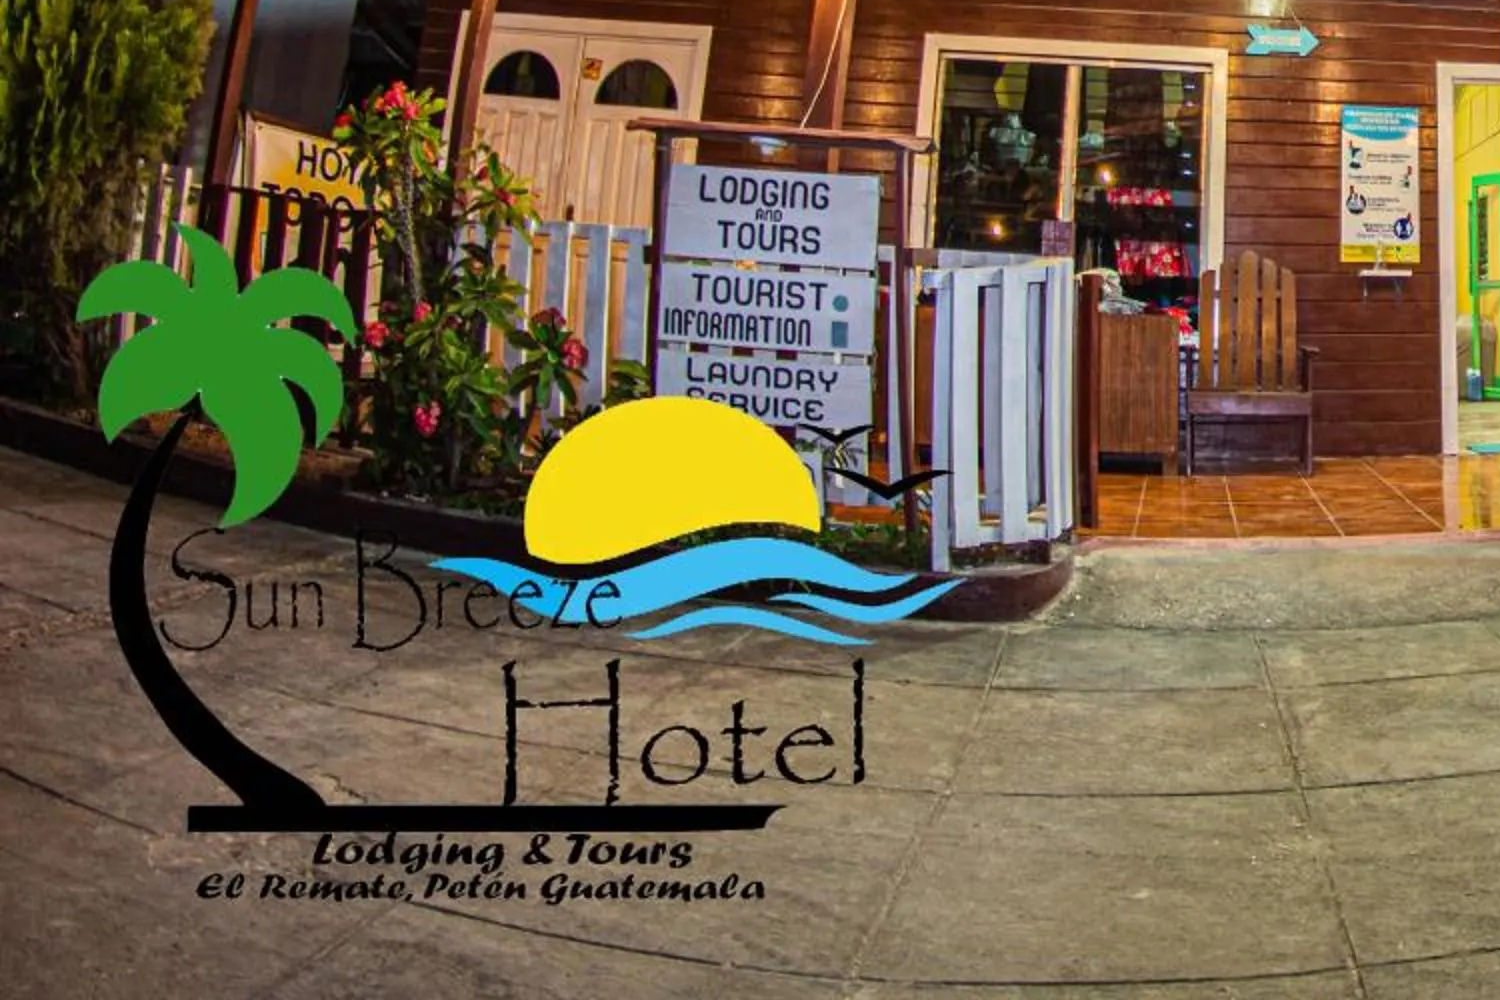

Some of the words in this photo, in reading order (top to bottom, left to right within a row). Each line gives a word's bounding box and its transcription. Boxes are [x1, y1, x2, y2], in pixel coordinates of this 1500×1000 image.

[699, 173, 831, 210] LODGING
[755, 208, 783, 222] AND
[717, 220, 822, 255] TOURS
[692, 273, 828, 311] TOURIST
[663, 307, 811, 346] INFORMATION
[686, 357, 838, 393] LAUNDRY
